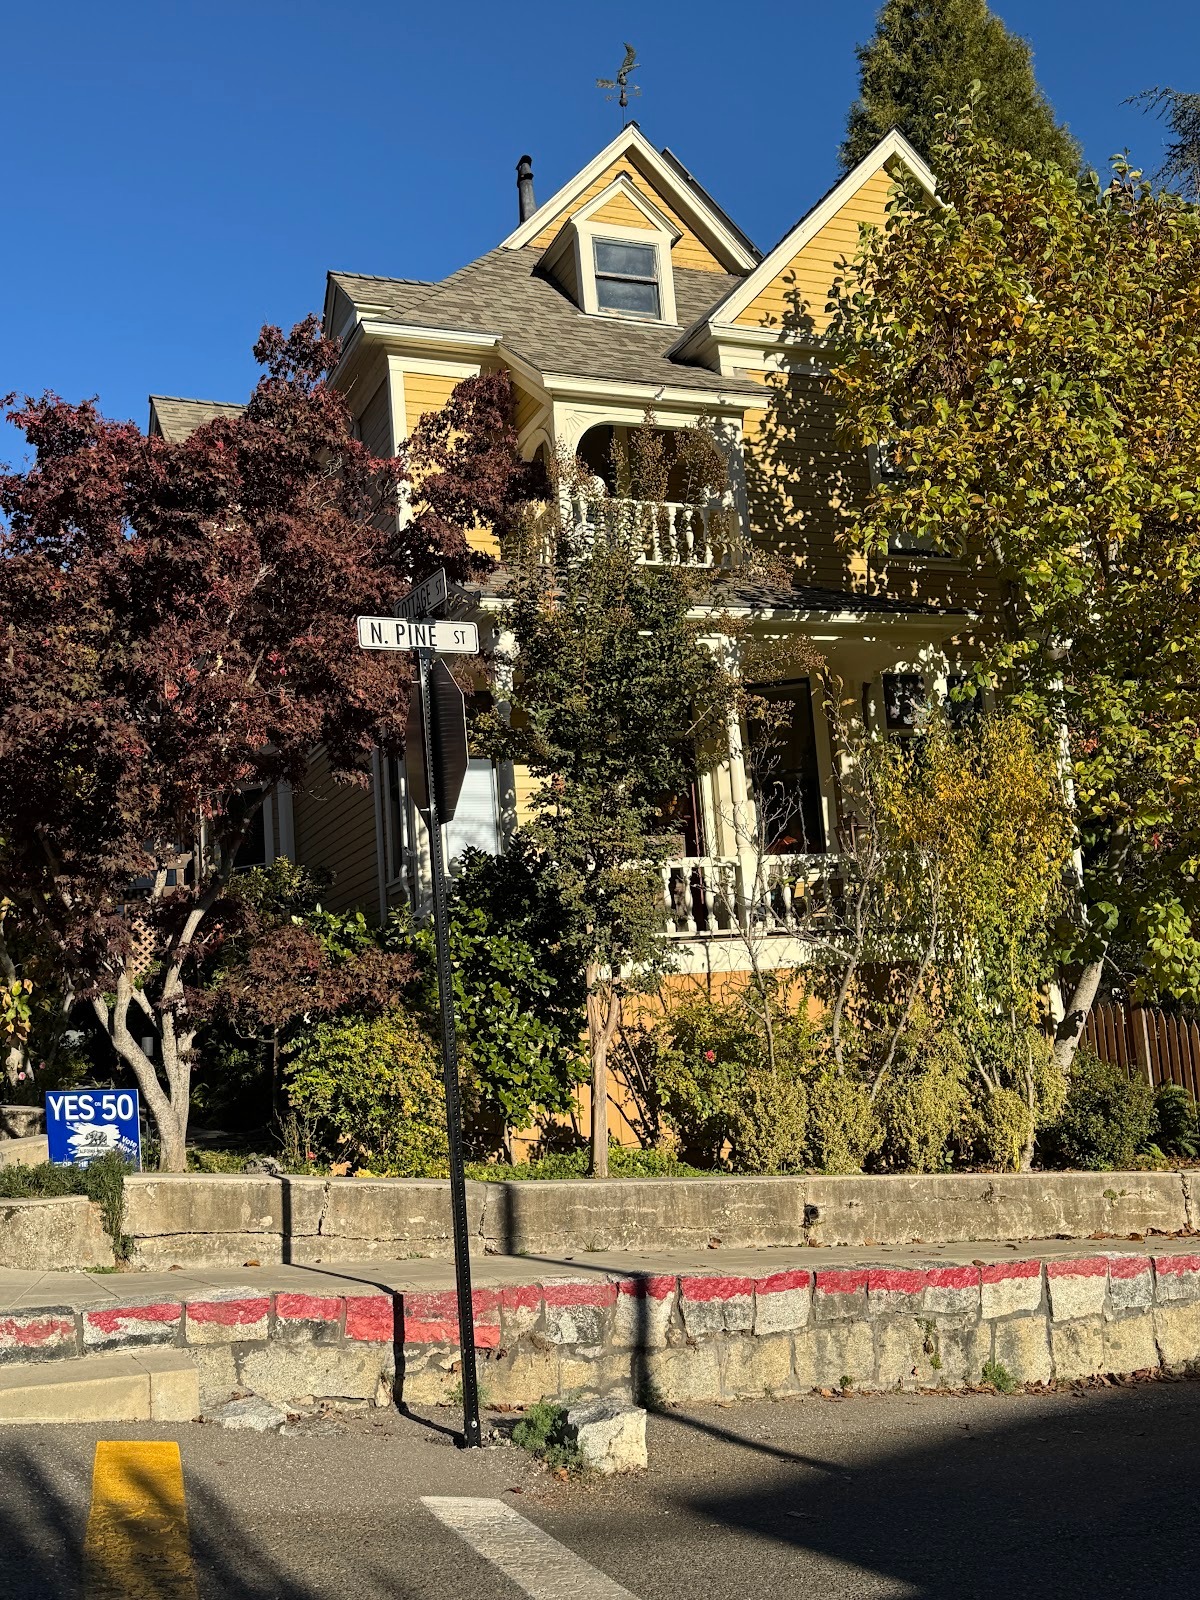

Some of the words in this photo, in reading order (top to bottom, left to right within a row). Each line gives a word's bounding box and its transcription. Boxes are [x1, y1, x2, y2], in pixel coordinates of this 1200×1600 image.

[435, 578, 443, 596] ST
[370, 622, 389, 644] N.
[395, 623, 438, 647] PINE
[453, 630, 466, 645] ST
[48, 1095, 95, 1121] YES
[101, 1094, 134, 1120] 50
